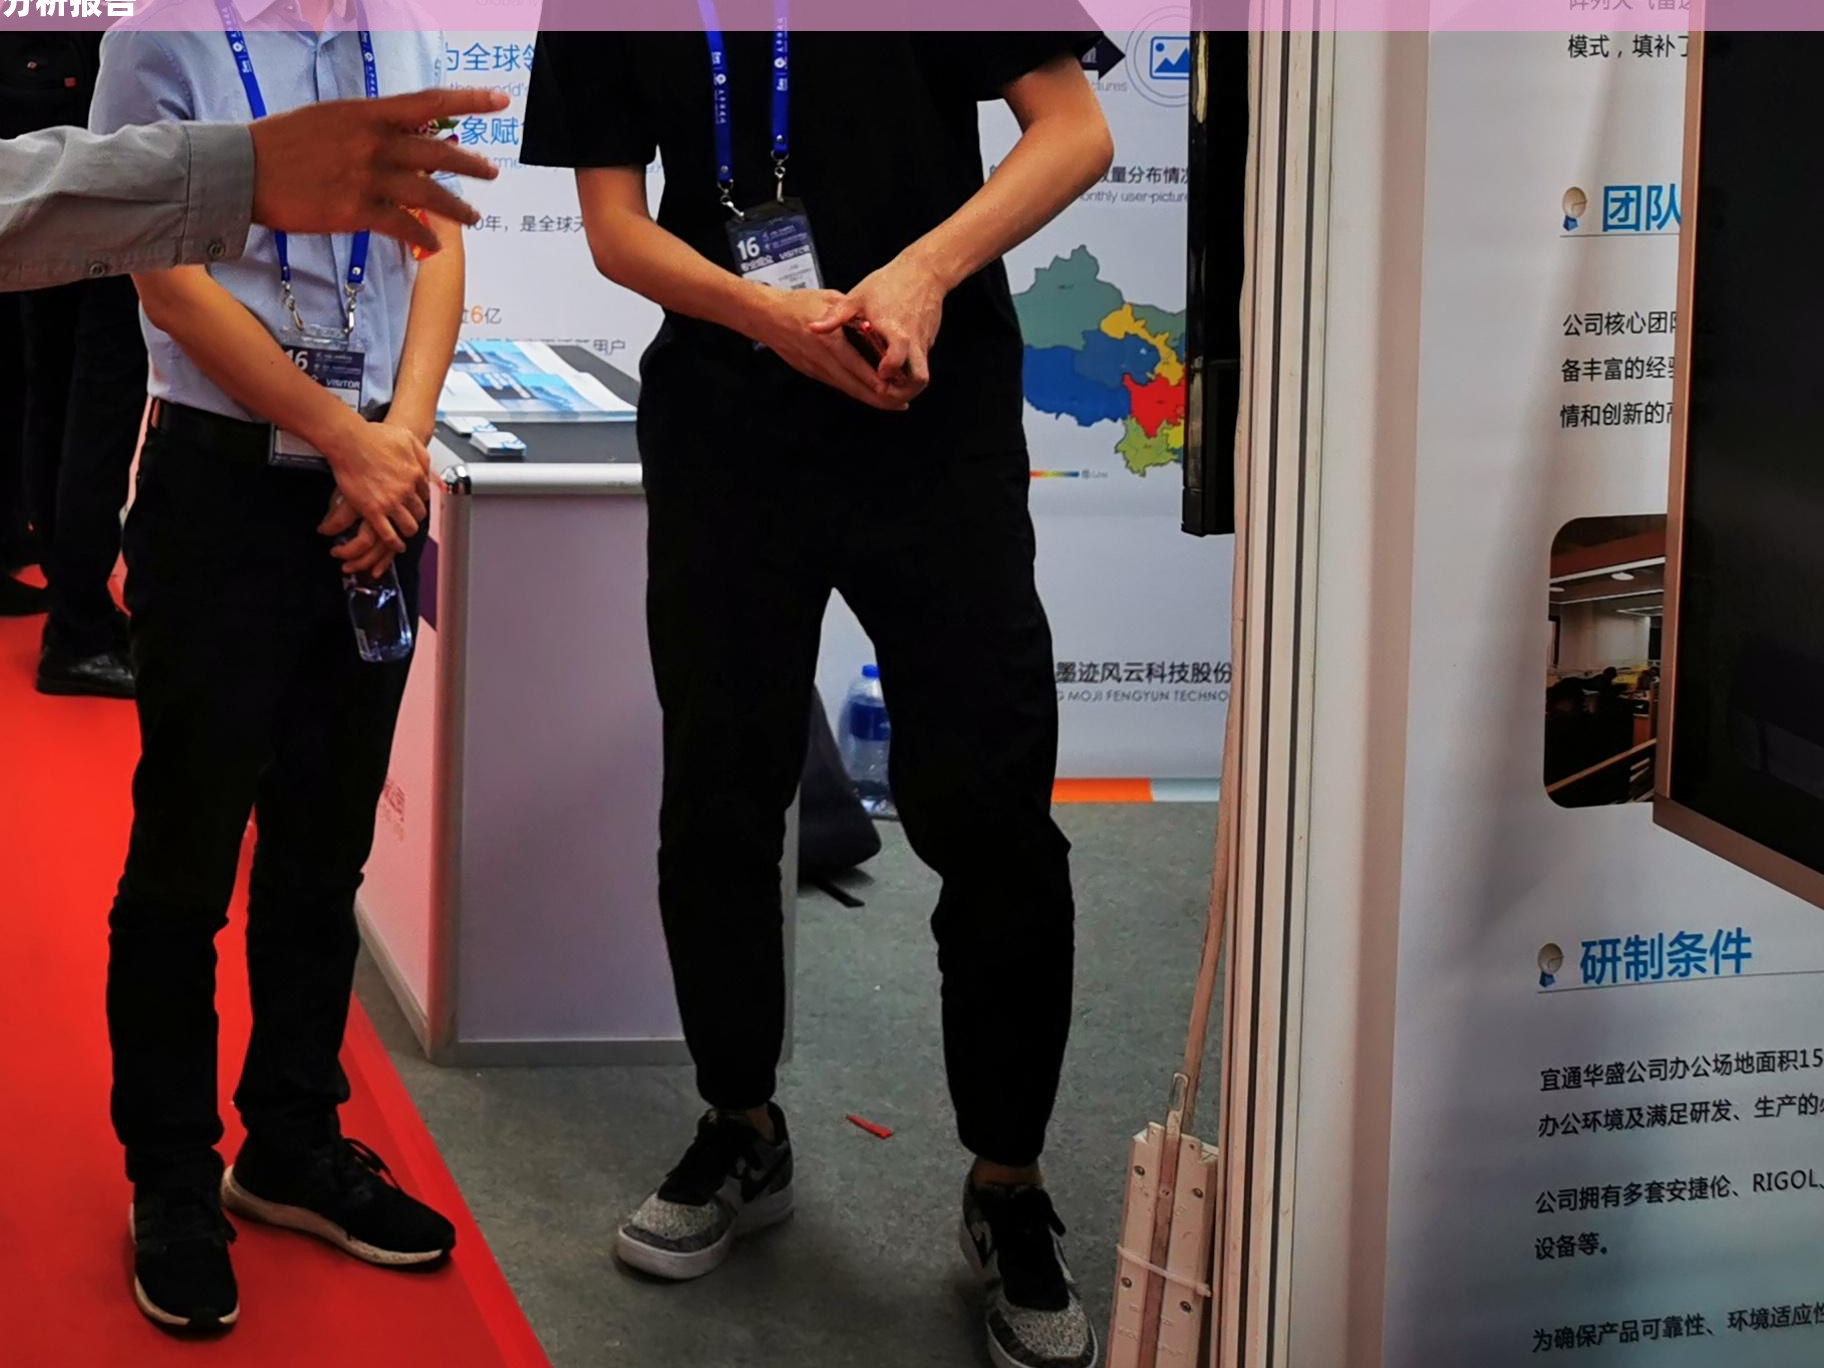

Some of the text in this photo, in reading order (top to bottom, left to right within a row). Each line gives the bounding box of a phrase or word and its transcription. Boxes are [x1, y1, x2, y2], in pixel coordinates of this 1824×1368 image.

[461, 115, 525, 145] 象赋
[1602, 184, 1682, 232] 团队
[737, 236, 760, 260] 16
[1056, 661, 1233, 684] 墨迹风云科技股份
[1580, 927, 1753, 985] 研制条件
[1534, 1231, 1608, 1261] 设备等。
